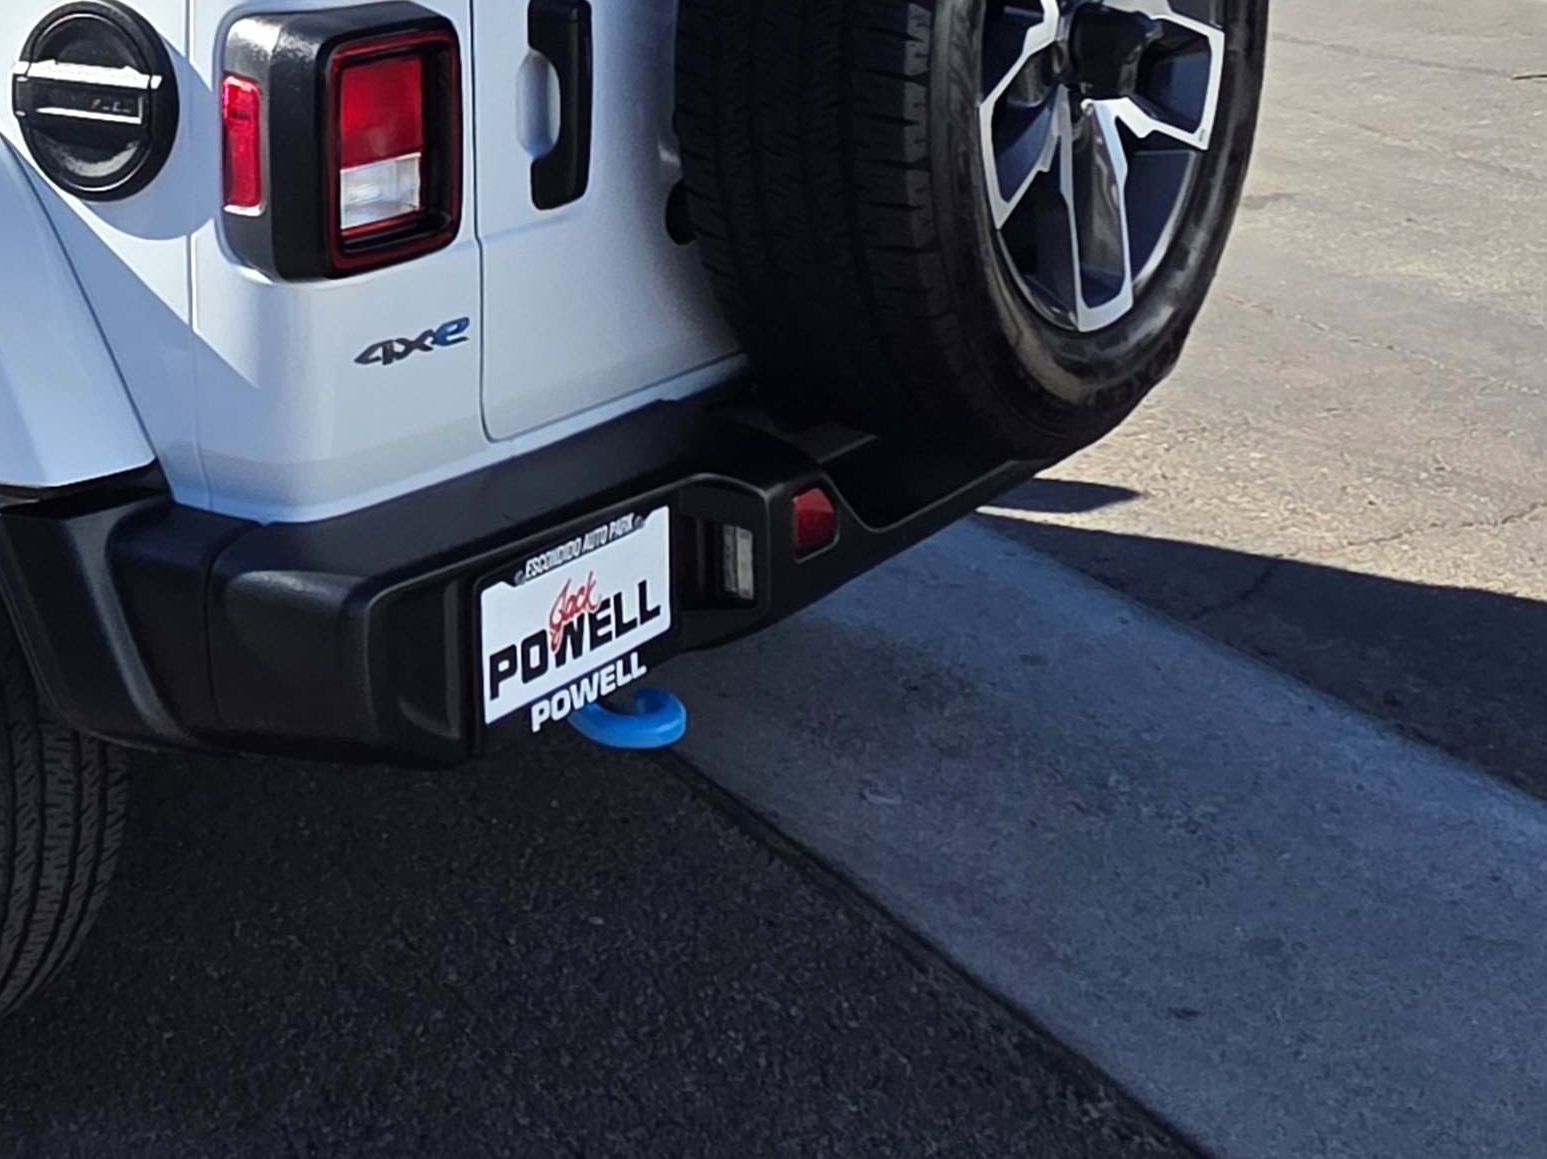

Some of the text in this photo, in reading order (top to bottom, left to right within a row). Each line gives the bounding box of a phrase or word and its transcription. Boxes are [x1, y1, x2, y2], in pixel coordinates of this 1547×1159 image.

[354, 316, 470, 366] 4xe
[582, 525, 609, 553] AUTO
[609, 512, 635, 541] PARK
[488, 579, 662, 702] POWELL
[530, 651, 648, 734] POWELL
